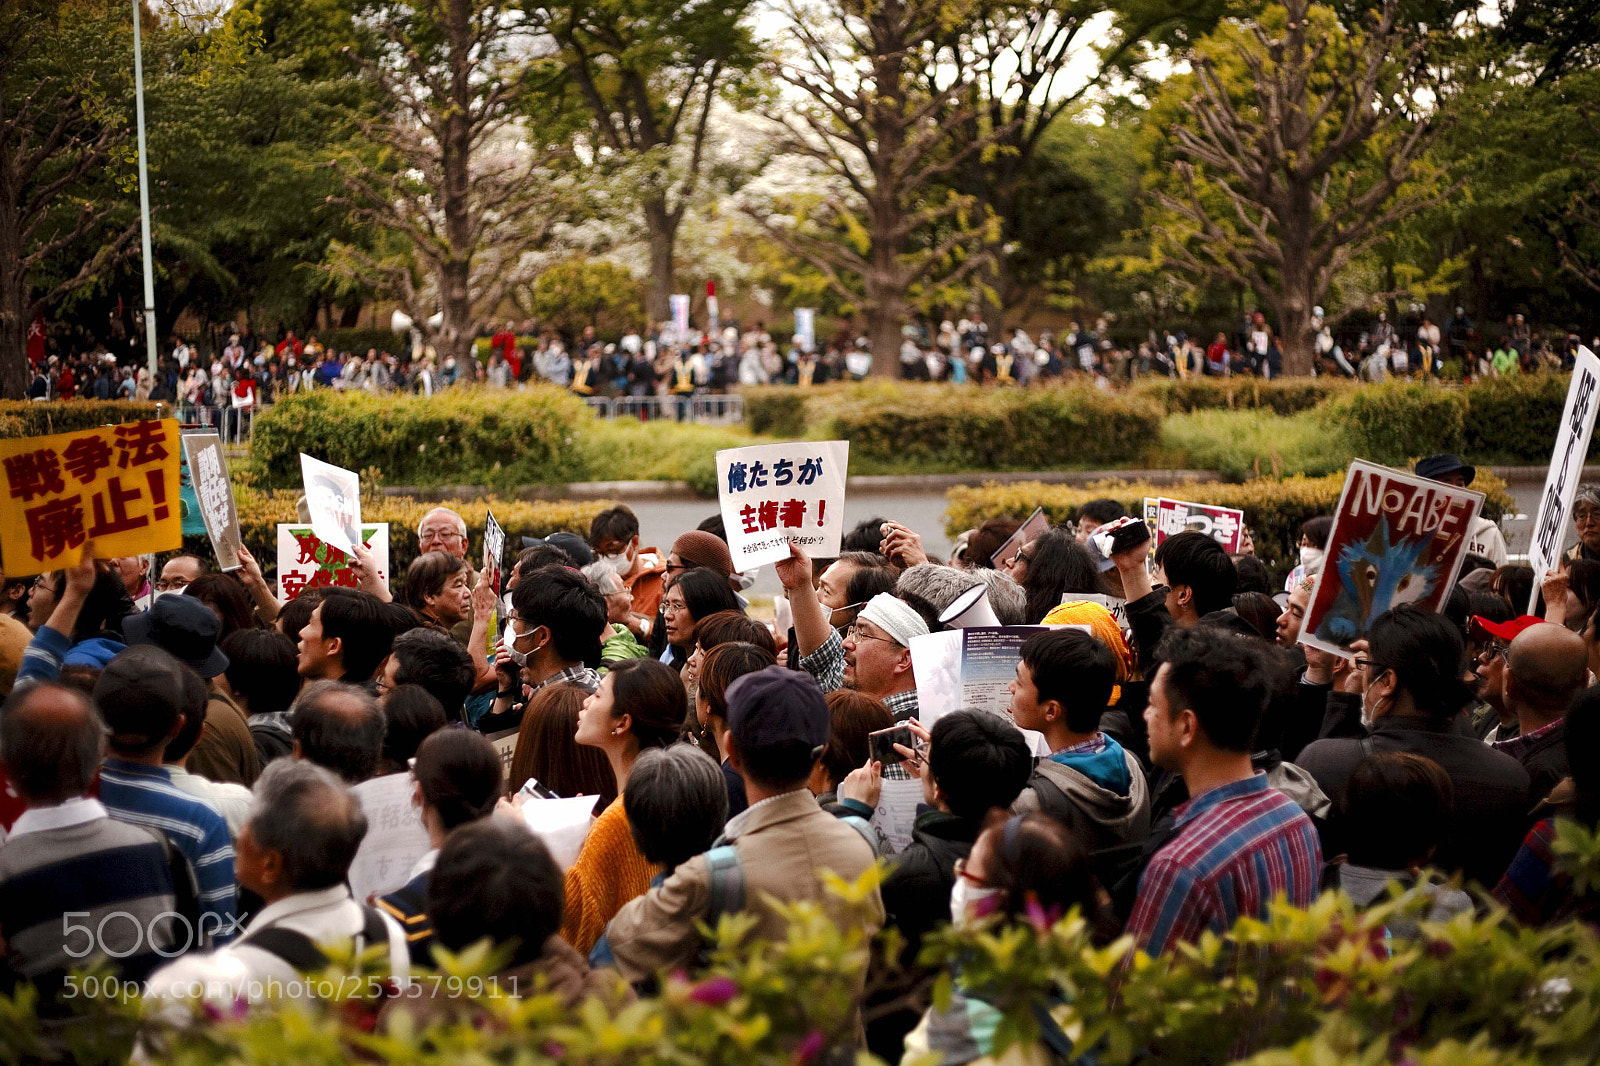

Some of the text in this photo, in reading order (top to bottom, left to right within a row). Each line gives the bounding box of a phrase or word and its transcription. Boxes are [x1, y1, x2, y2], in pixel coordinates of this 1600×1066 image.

[1, 419, 170, 503] 戦争法
[727, 456, 824, 494] 俺たちが
[23, 468, 171, 565] 廃止！
[739, 498, 826, 535] 主権者！
[1159, 503, 1238, 544] 嘘つき
